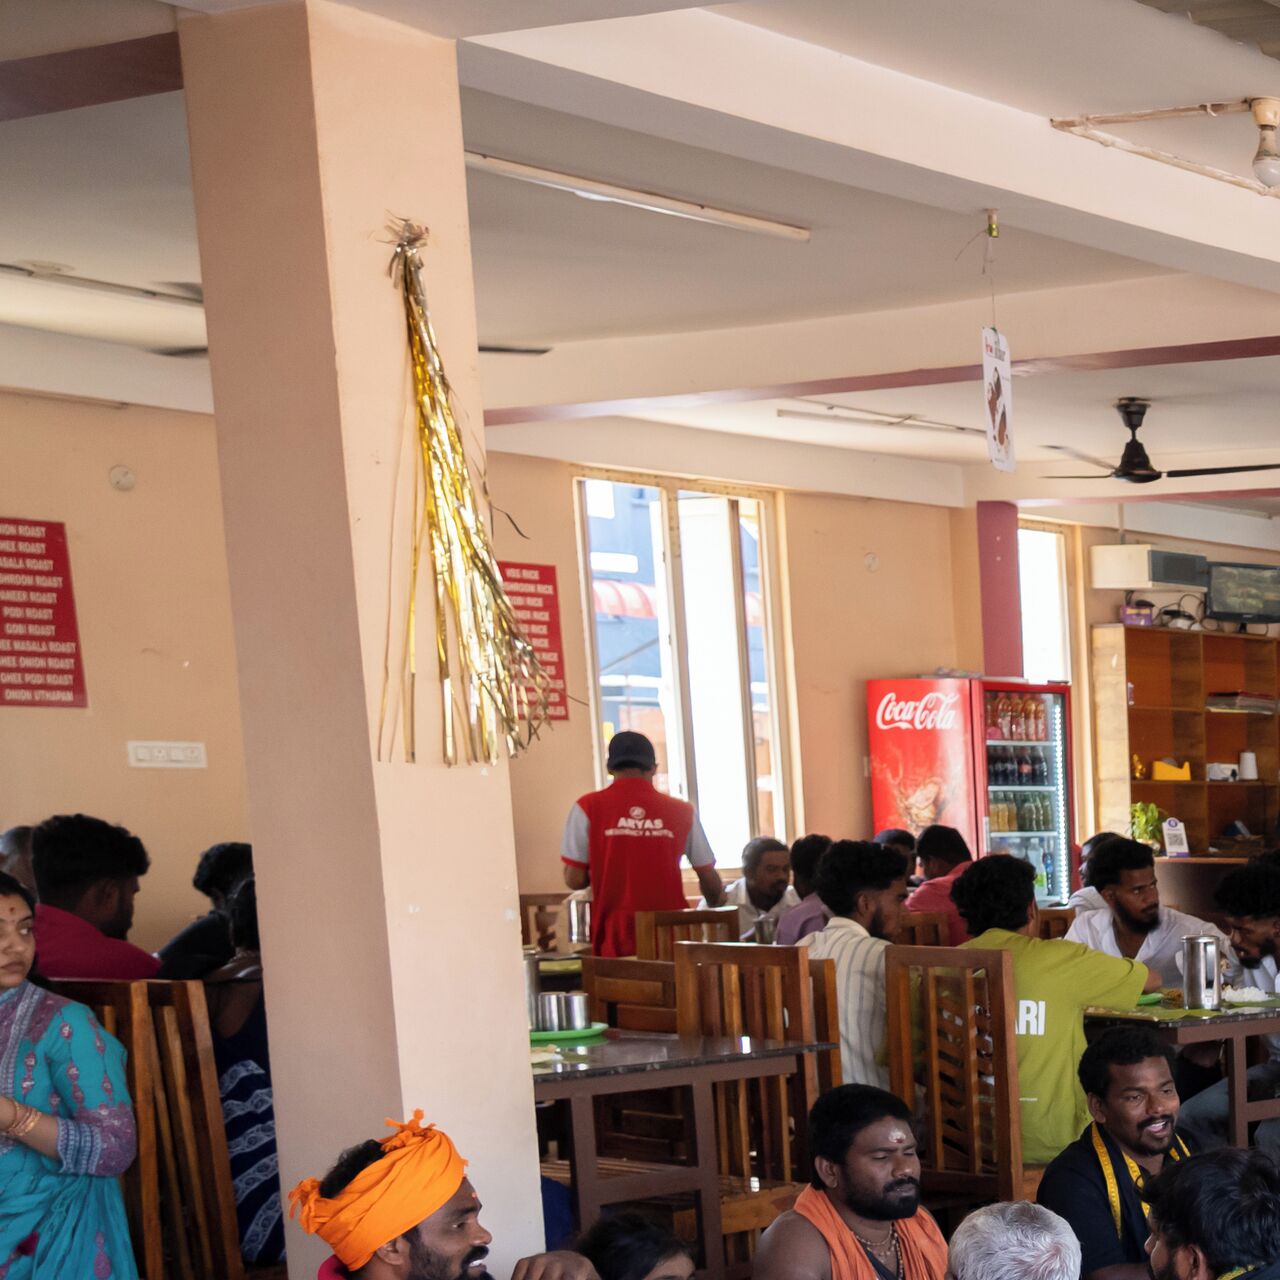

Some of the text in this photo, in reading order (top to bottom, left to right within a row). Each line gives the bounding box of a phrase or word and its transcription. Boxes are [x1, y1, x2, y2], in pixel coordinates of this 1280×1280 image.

[18, 525, 46, 538] ROAST
[18, 541, 46, 554] ROAST
[25, 558, 54, 571] ROAST
[34, 575, 63, 588] ROAST
[29, 592, 57, 605] ROAST
[25, 607, 53, 620] ROAST
[27, 623, 56, 637] ROAST
[13, 640, 48, 652] MASALA
[48, 641, 76, 654] ROAST
[19, 656, 46, 669] ONION
[47, 657, 75, 670] ROAST
[45, 674, 74, 687] ROAST
[4, 688, 33, 701] ONION
[876, 692, 961, 730] Coca-Cola
[617, 817, 663, 829] ARYAS
[1015, 999, 1046, 1036] RI
